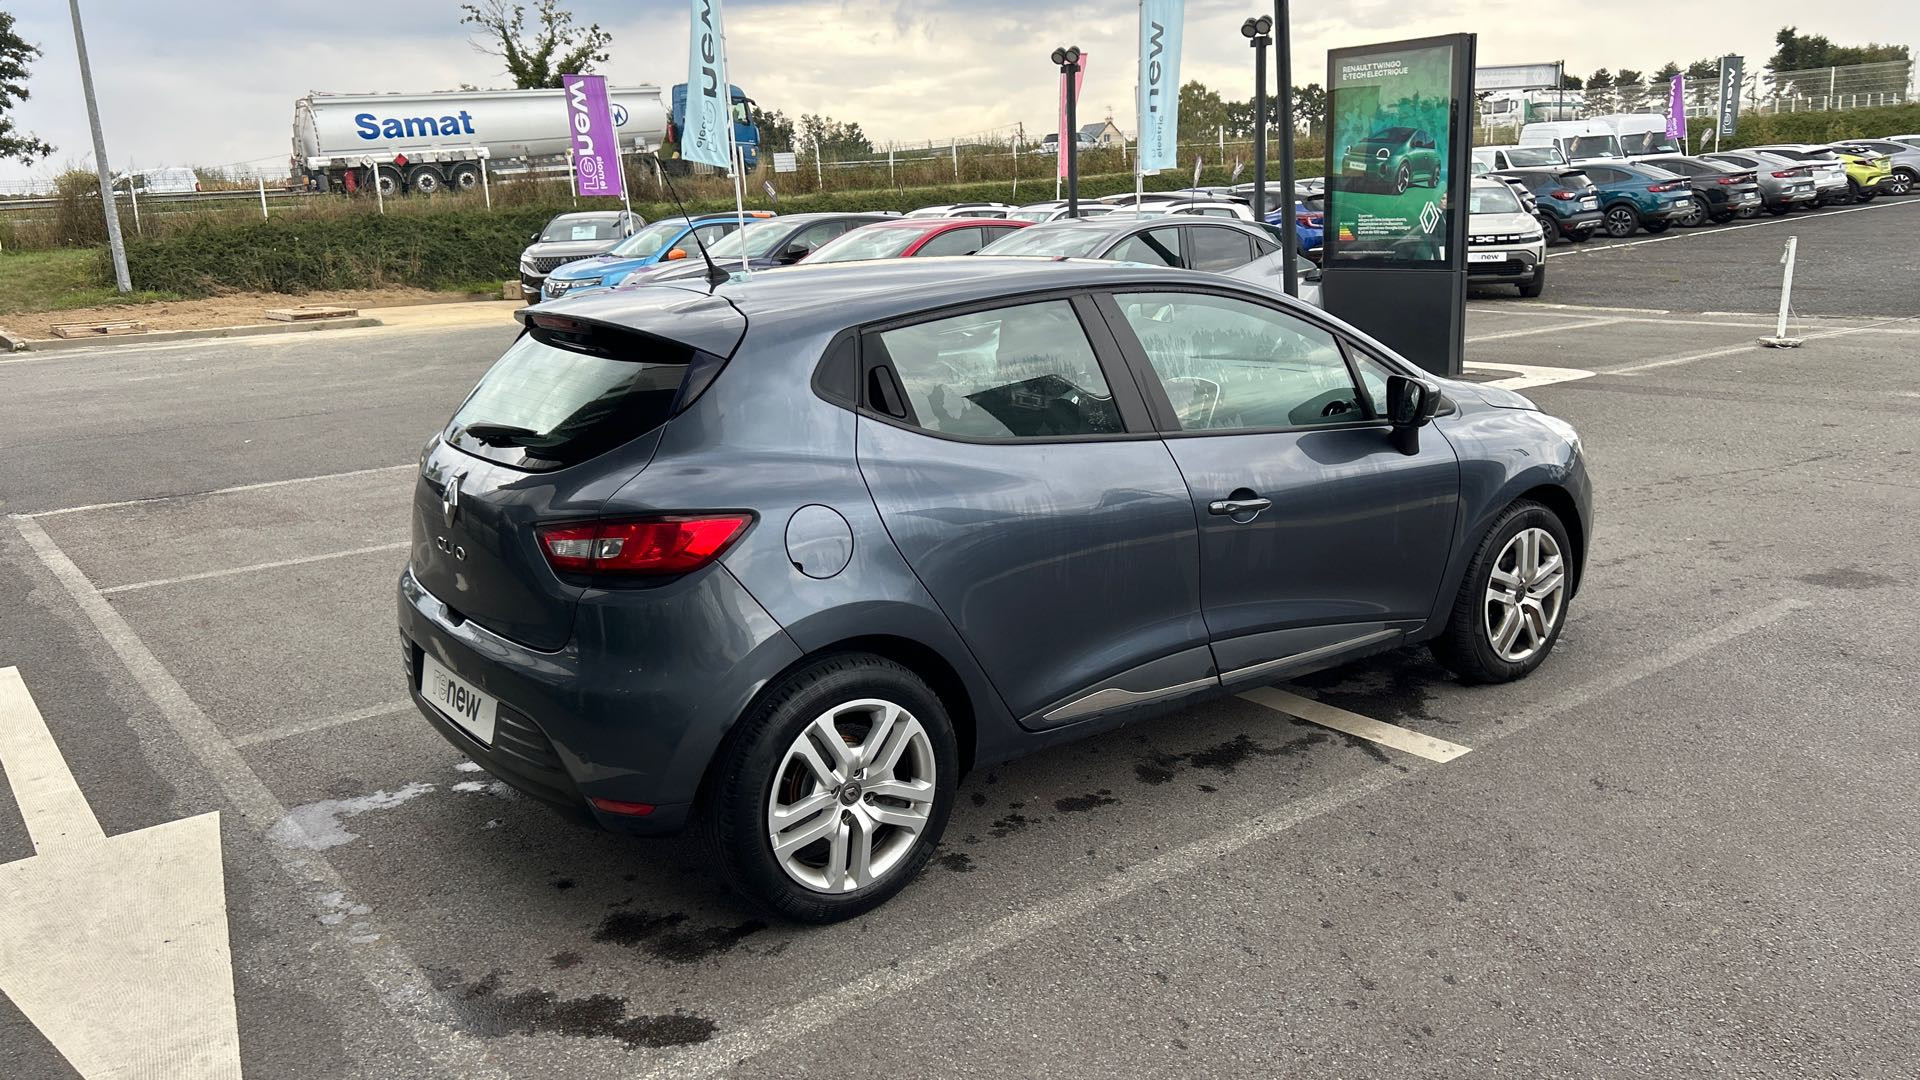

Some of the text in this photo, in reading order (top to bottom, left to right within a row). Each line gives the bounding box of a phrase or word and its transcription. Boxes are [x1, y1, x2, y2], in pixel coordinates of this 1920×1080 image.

[1342, 60, 1401, 73] RENAULT TWINGO
[1342, 66, 1409, 81] E-TECH ELECTRIQUE
[1722, 67, 1736, 134] renew
[354, 110, 475, 140] Samat
[436, 536, 466, 561] CLIO
[432, 668, 482, 722] renew
